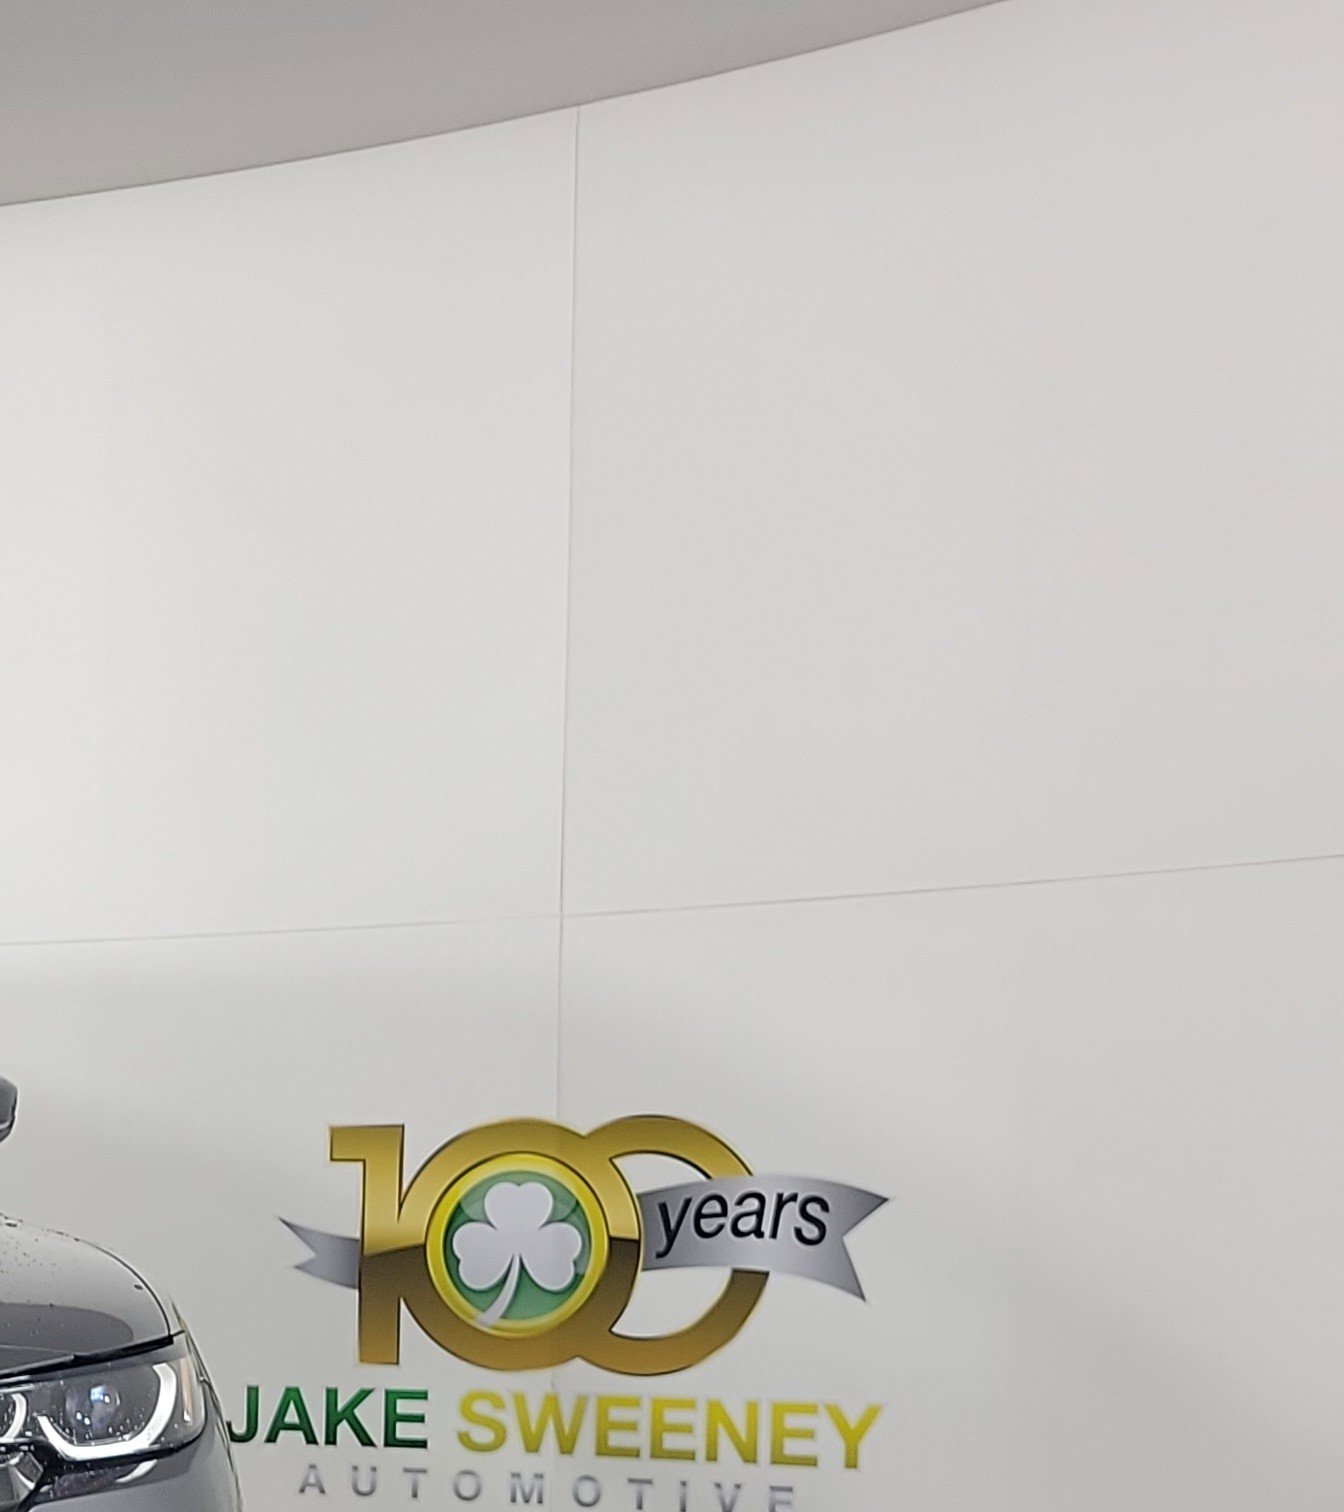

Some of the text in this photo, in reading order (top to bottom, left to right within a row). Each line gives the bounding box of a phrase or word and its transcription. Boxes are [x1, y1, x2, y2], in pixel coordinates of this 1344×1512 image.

[656, 1190, 829, 1258] years
[226, 1386, 882, 1469] JAKE SWEENEY
